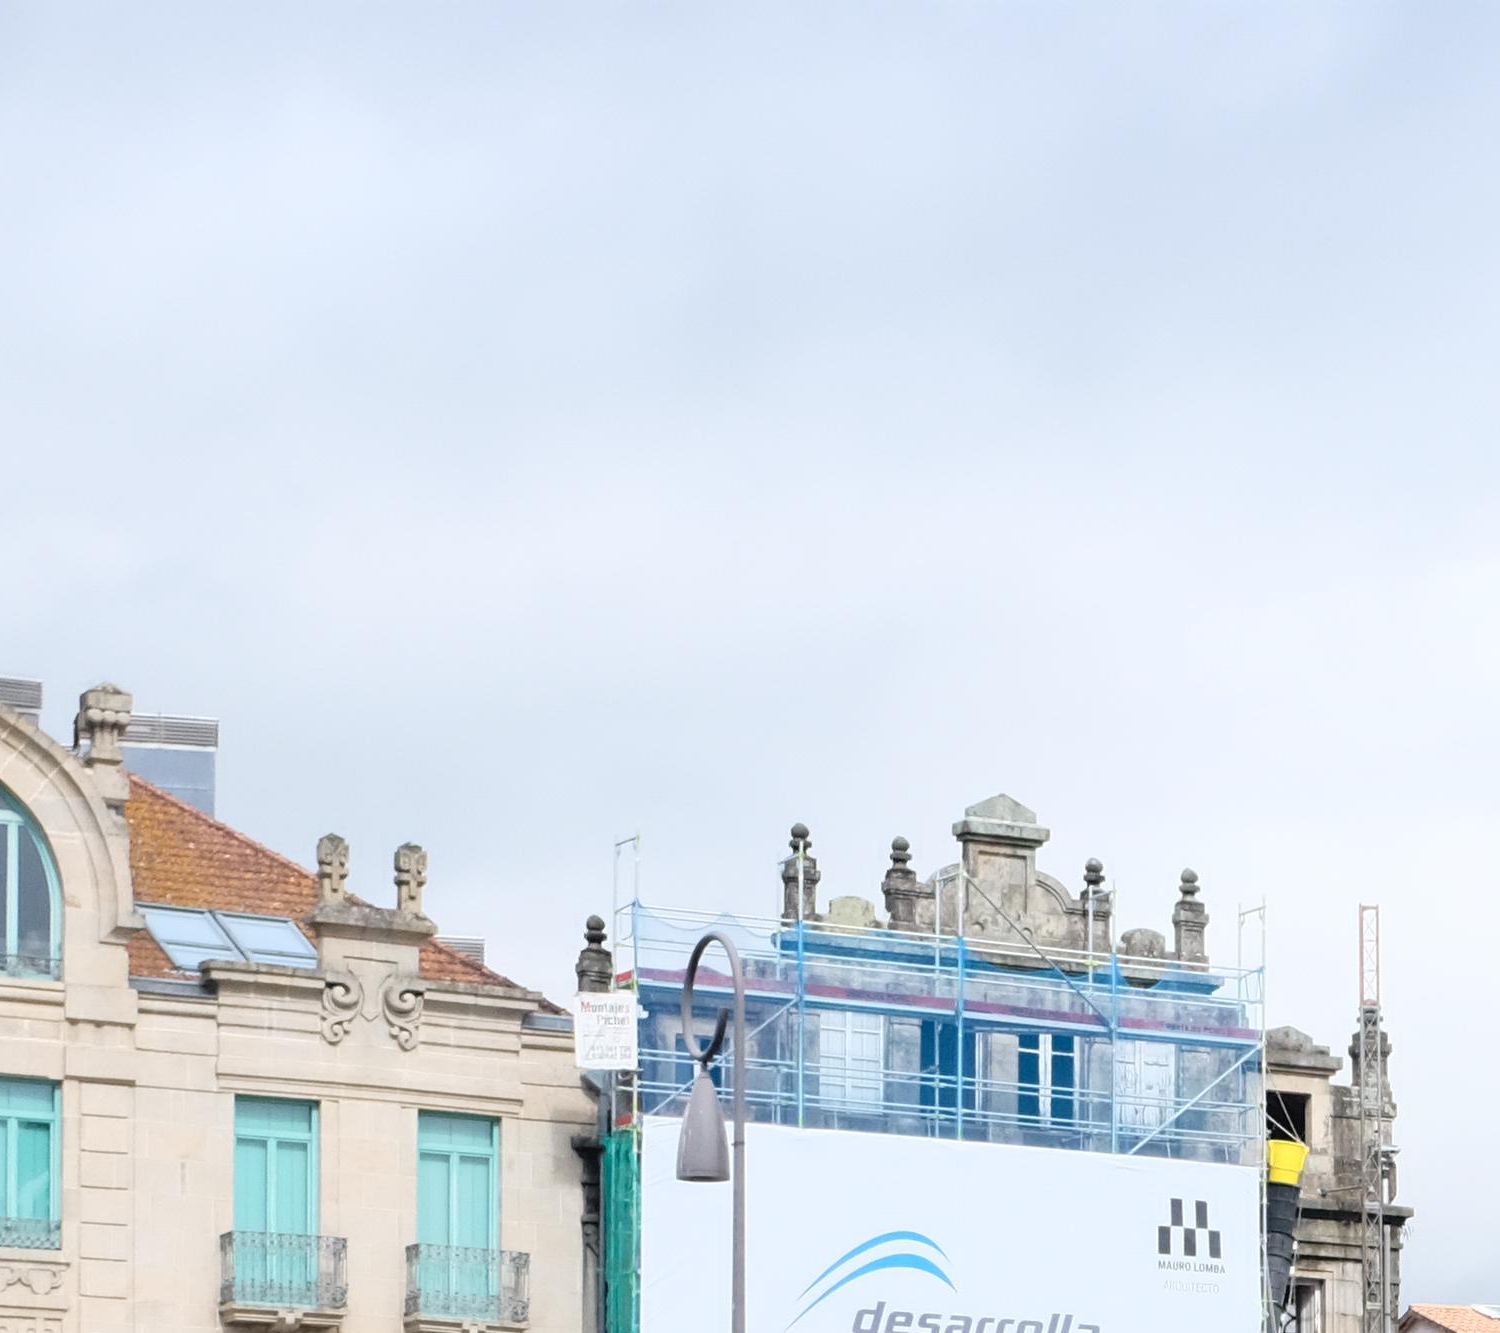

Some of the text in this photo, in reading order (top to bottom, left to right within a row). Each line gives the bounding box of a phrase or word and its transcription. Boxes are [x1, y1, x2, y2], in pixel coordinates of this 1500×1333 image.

[580, 1001, 631, 1015] Montajes
[1158, 1260, 1226, 1274] MAURO LOMBA
